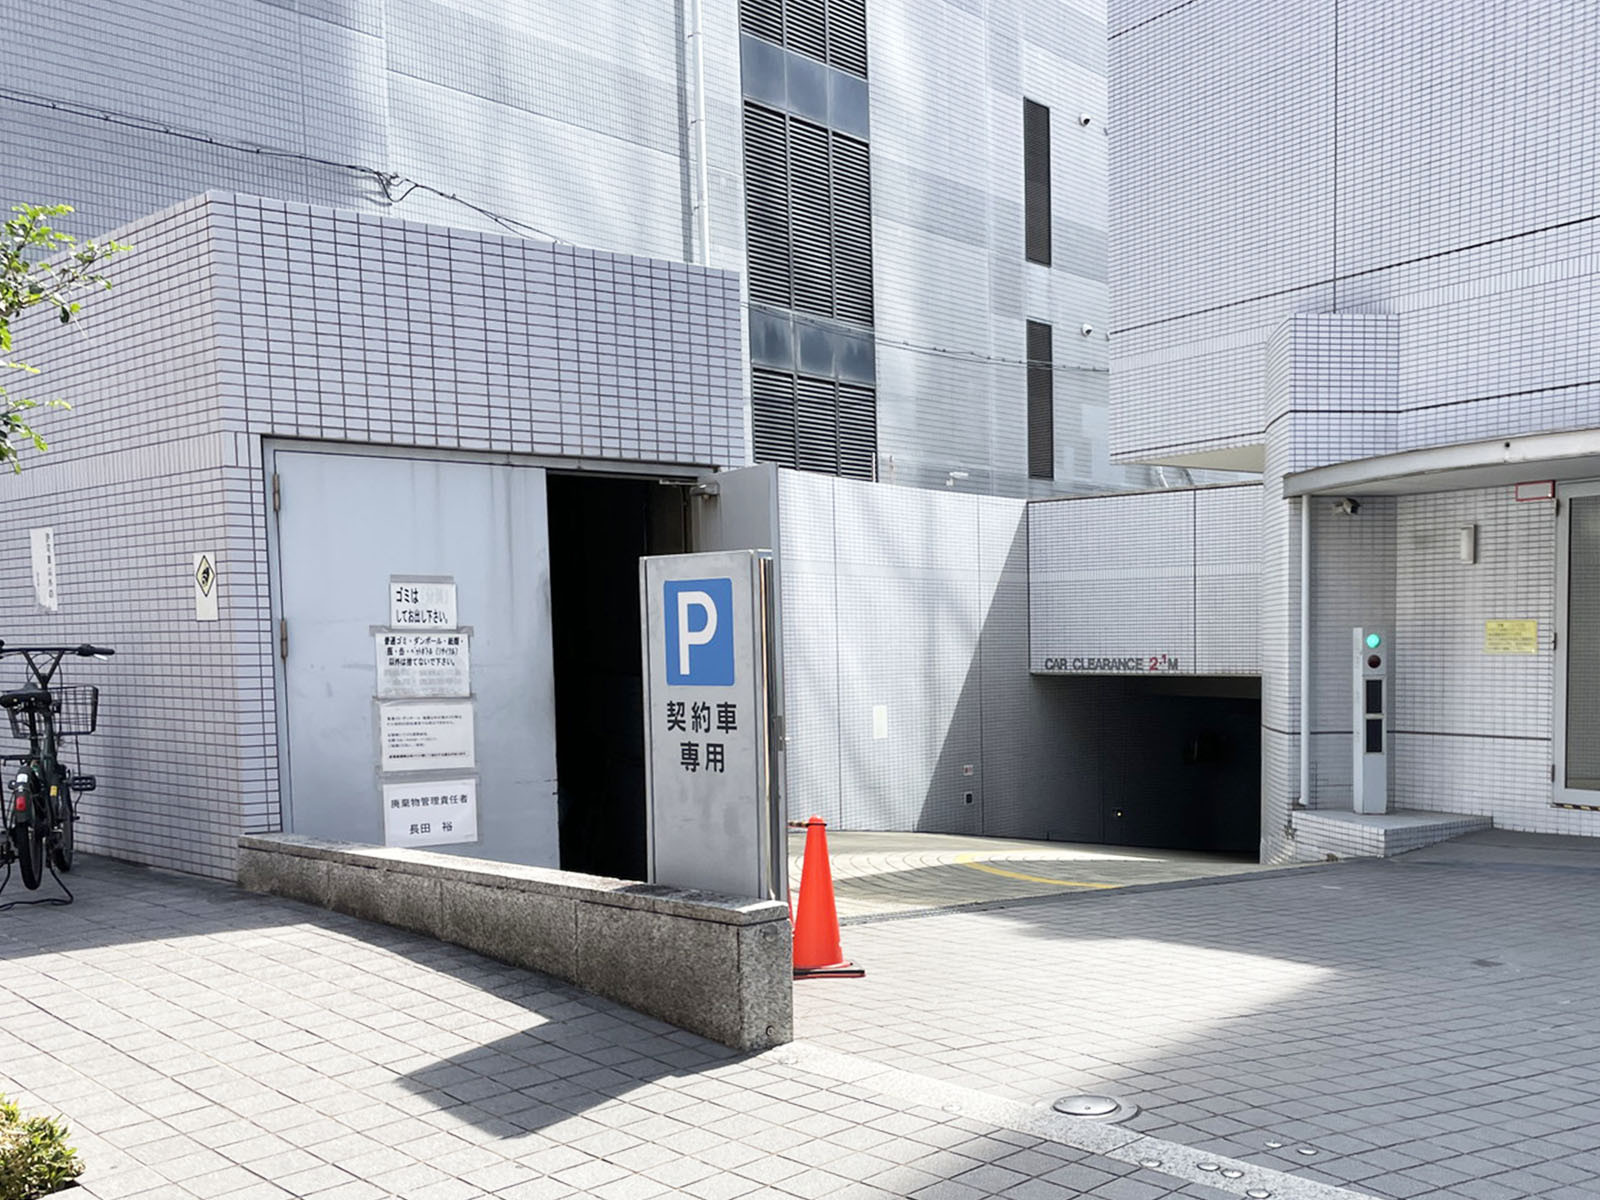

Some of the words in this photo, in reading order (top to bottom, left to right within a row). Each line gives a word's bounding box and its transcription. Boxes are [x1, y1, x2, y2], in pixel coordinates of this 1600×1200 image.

[395, 587, 419, 604] ゴミは
[395, 609, 449, 624] してお出し下さい。
[677, 590, 718, 675] P
[1044, 657, 1068, 671] CAR
[1073, 657, 1144, 671] CLEARANCE
[666, 700, 738, 734] 契約車
[680, 740, 725, 773] 専用
[390, 794, 468, 809] 廃棄物管理責任者
[409, 823, 431, 835] 長田
